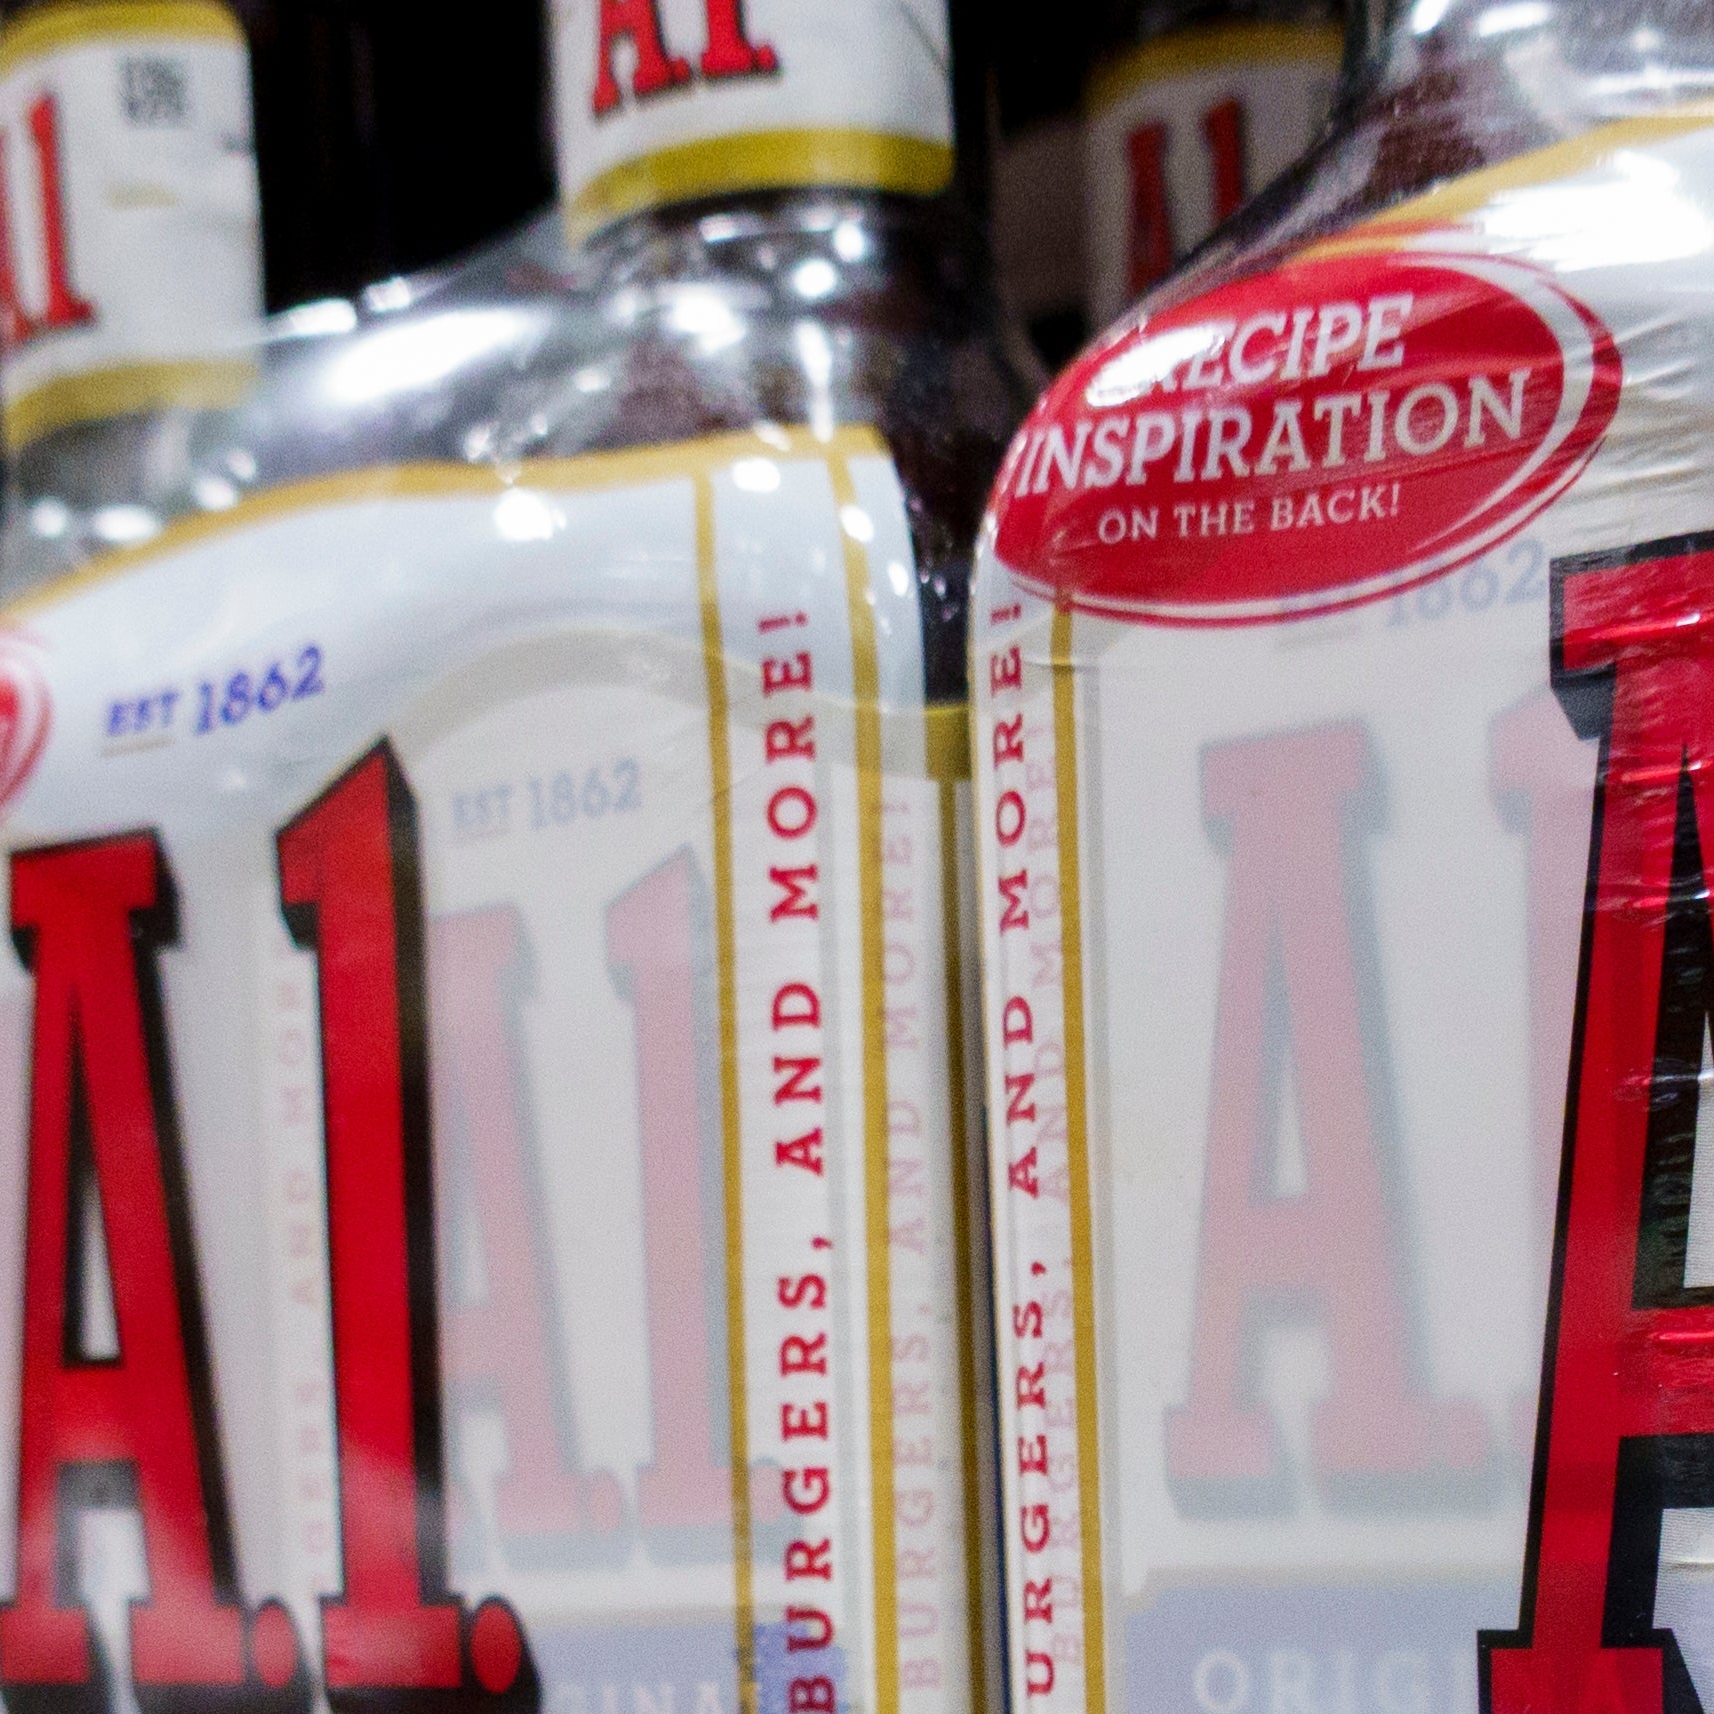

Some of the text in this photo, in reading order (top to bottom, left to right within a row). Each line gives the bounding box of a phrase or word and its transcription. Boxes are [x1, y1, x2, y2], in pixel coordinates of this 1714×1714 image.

[1132, 293, 1417, 402] ECIPE
[1014, 366, 1533, 500] INSPIRATION
[1097, 482, 1402, 545] ON THE BACK!
[104, 641, 327, 738] EST 1862
[758, 611, 820, 922] MORE!
[990, 603, 1030, 932] MORE!
[770, 981, 825, 1177] AND
[1003, 996, 1040, 1198] AND
